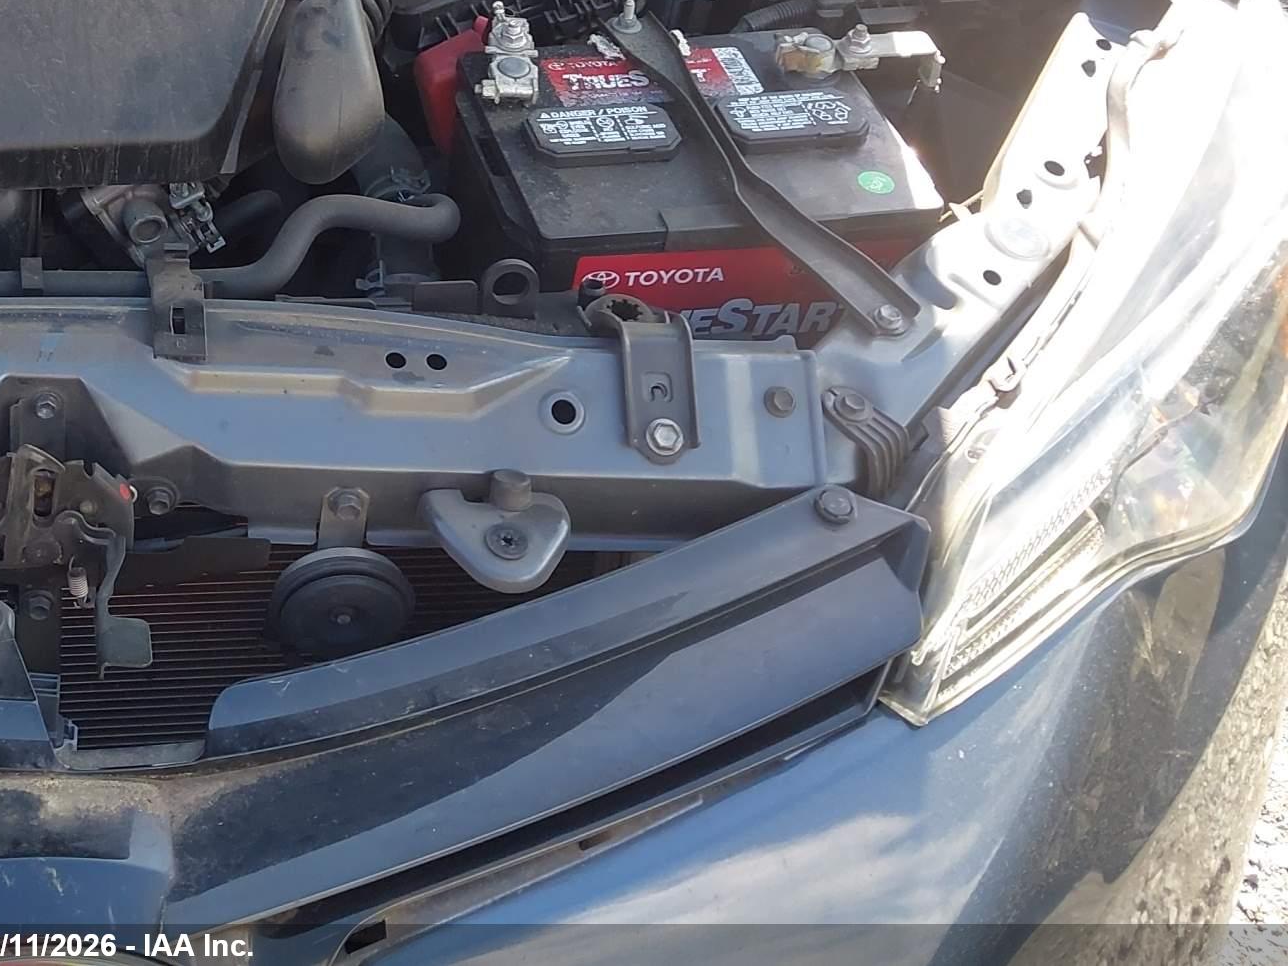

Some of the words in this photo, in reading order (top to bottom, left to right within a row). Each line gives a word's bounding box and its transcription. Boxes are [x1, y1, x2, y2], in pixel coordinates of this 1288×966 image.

[569, 60, 618, 69] TOYOTA
[550, 109, 596, 119] DANGER
[605, 106, 648, 115] POISON
[624, 267, 724, 287] TOYOTA
